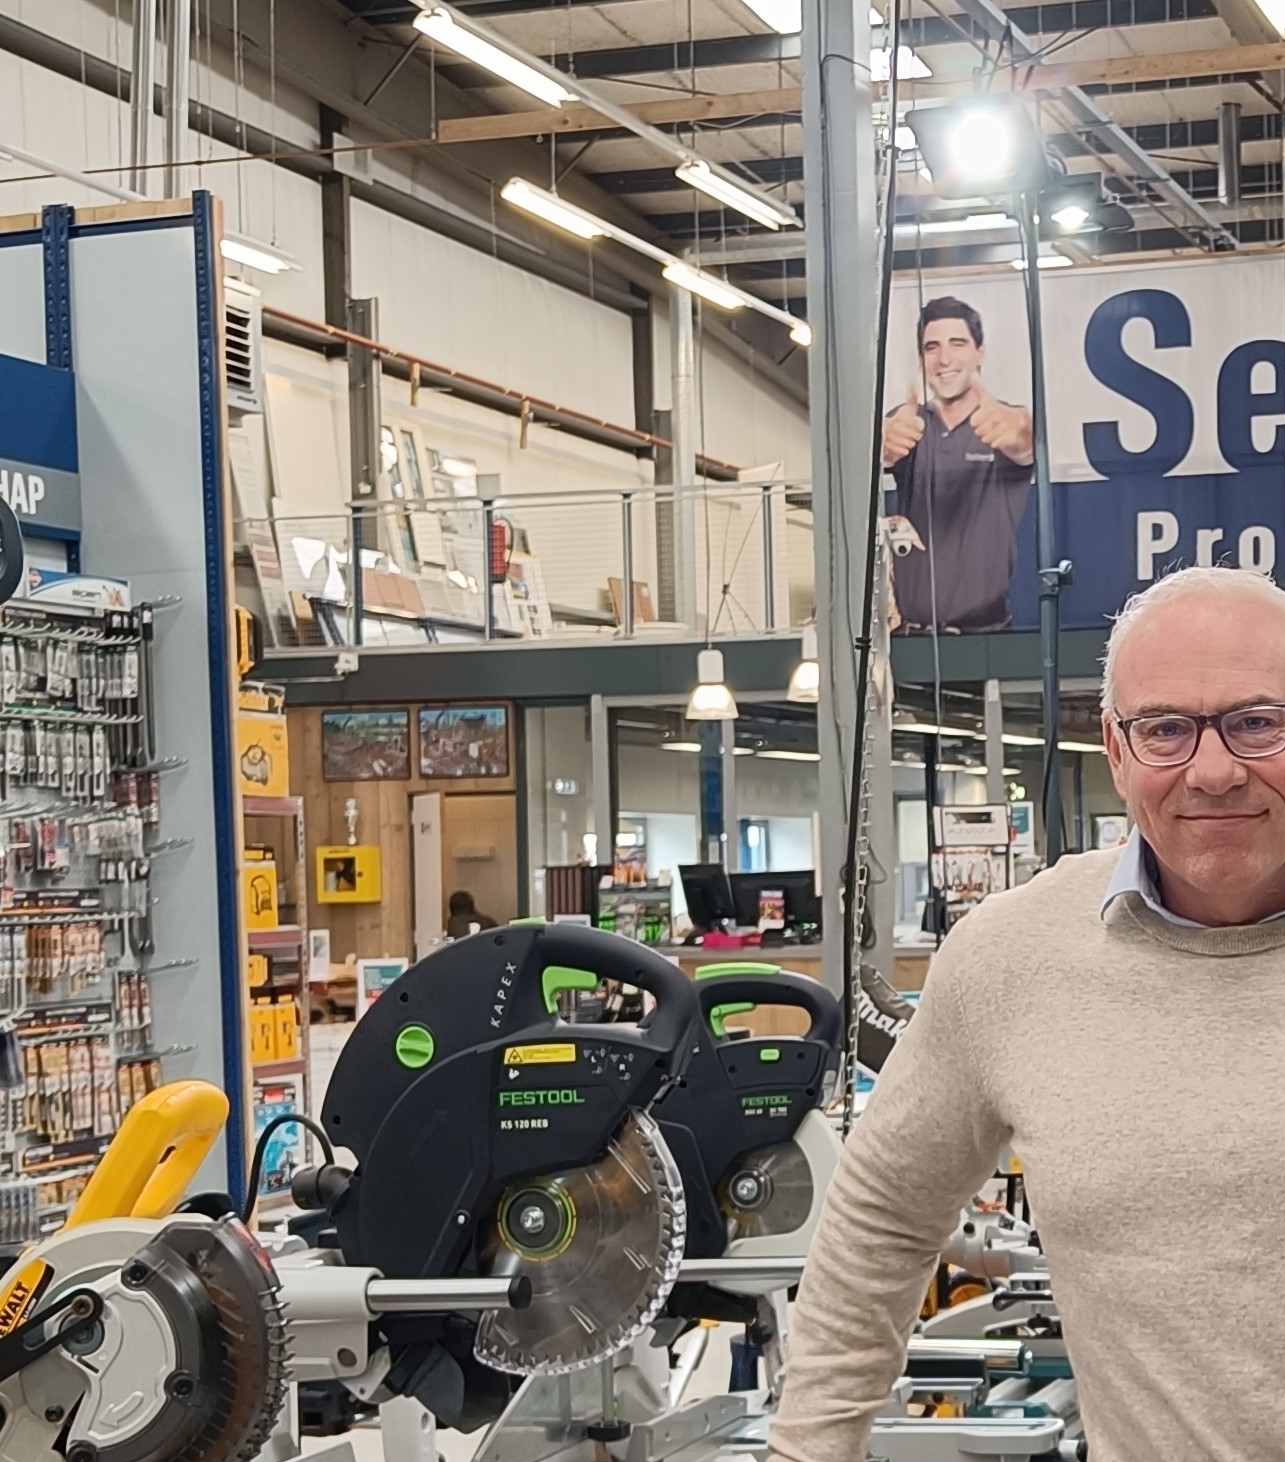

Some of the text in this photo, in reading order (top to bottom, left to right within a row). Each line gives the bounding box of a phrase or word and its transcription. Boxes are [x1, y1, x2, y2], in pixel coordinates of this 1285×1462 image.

[490, 961, 517, 1028] KAPEX
[499, 1089, 585, 1106] FESTOOL
[742, 1095, 792, 1107] FESTOOL
